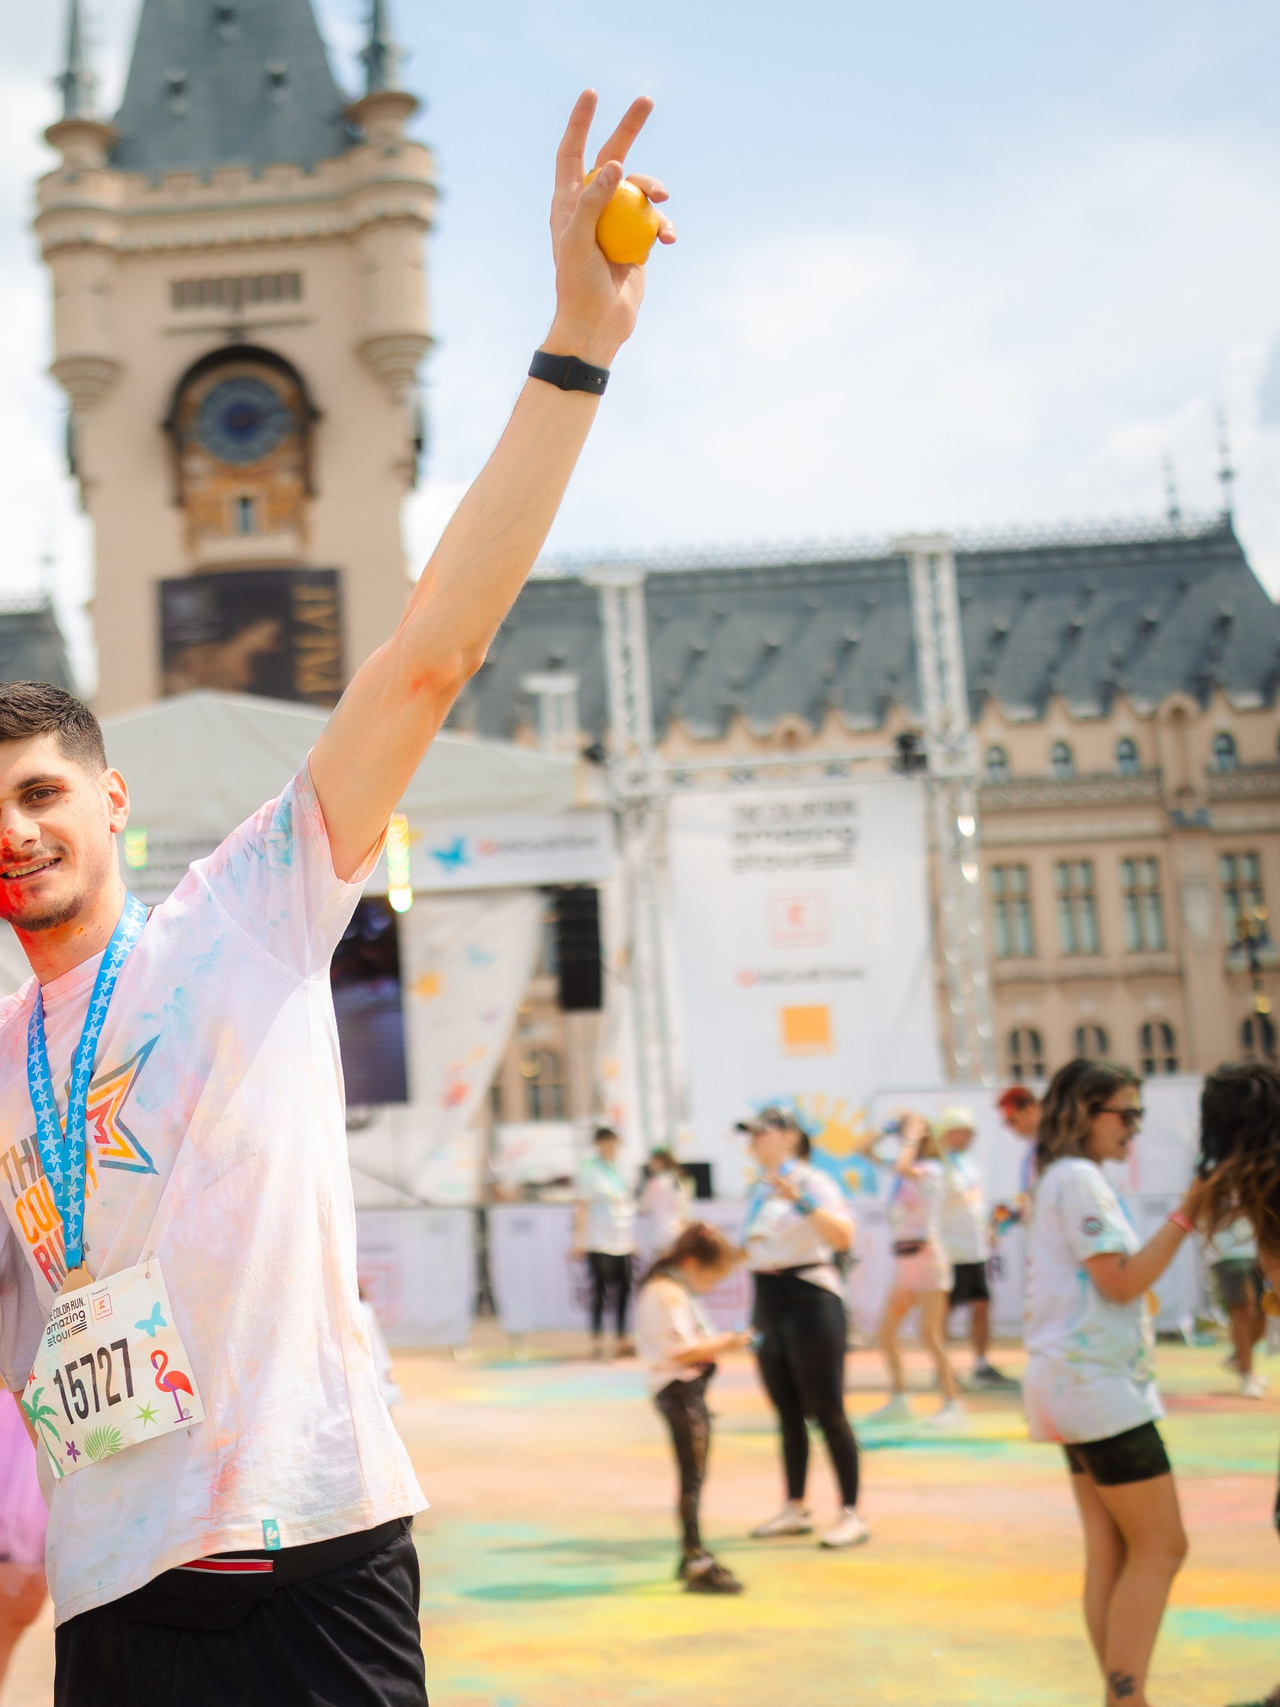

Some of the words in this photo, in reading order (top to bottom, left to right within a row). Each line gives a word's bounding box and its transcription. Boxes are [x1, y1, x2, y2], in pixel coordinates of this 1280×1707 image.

[33, 1225, 67, 1293] RU
[46, 1310, 86, 1335] amazing
[52, 1302, 71, 1320] COLOR
[53, 1338, 134, 1425] 15727
